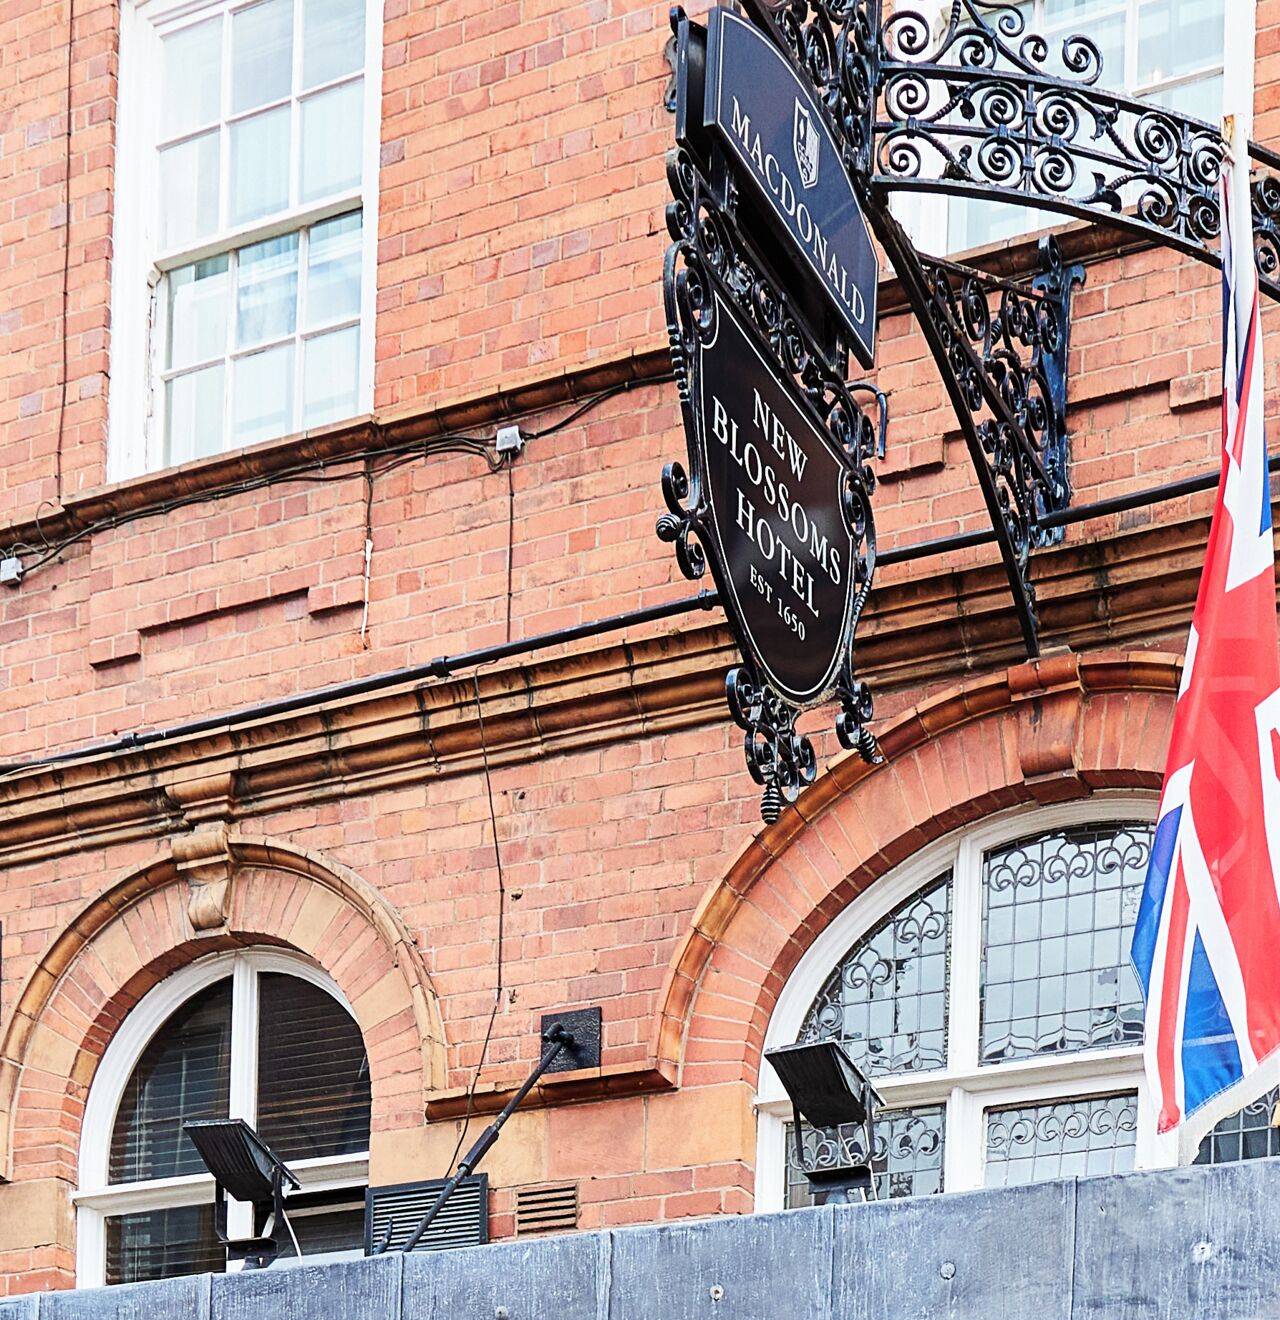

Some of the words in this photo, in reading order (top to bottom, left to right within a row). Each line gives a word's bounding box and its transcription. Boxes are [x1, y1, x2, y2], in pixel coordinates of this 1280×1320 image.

[731, 96, 866, 325] MACDONALD
[712, 395, 841, 585] BLOSSOMS
[753, 387, 808, 483] NEW
[736, 487, 819, 618] HOTEL
[750, 564, 773, 604] EST
[777, 597, 806, 641] 1650
